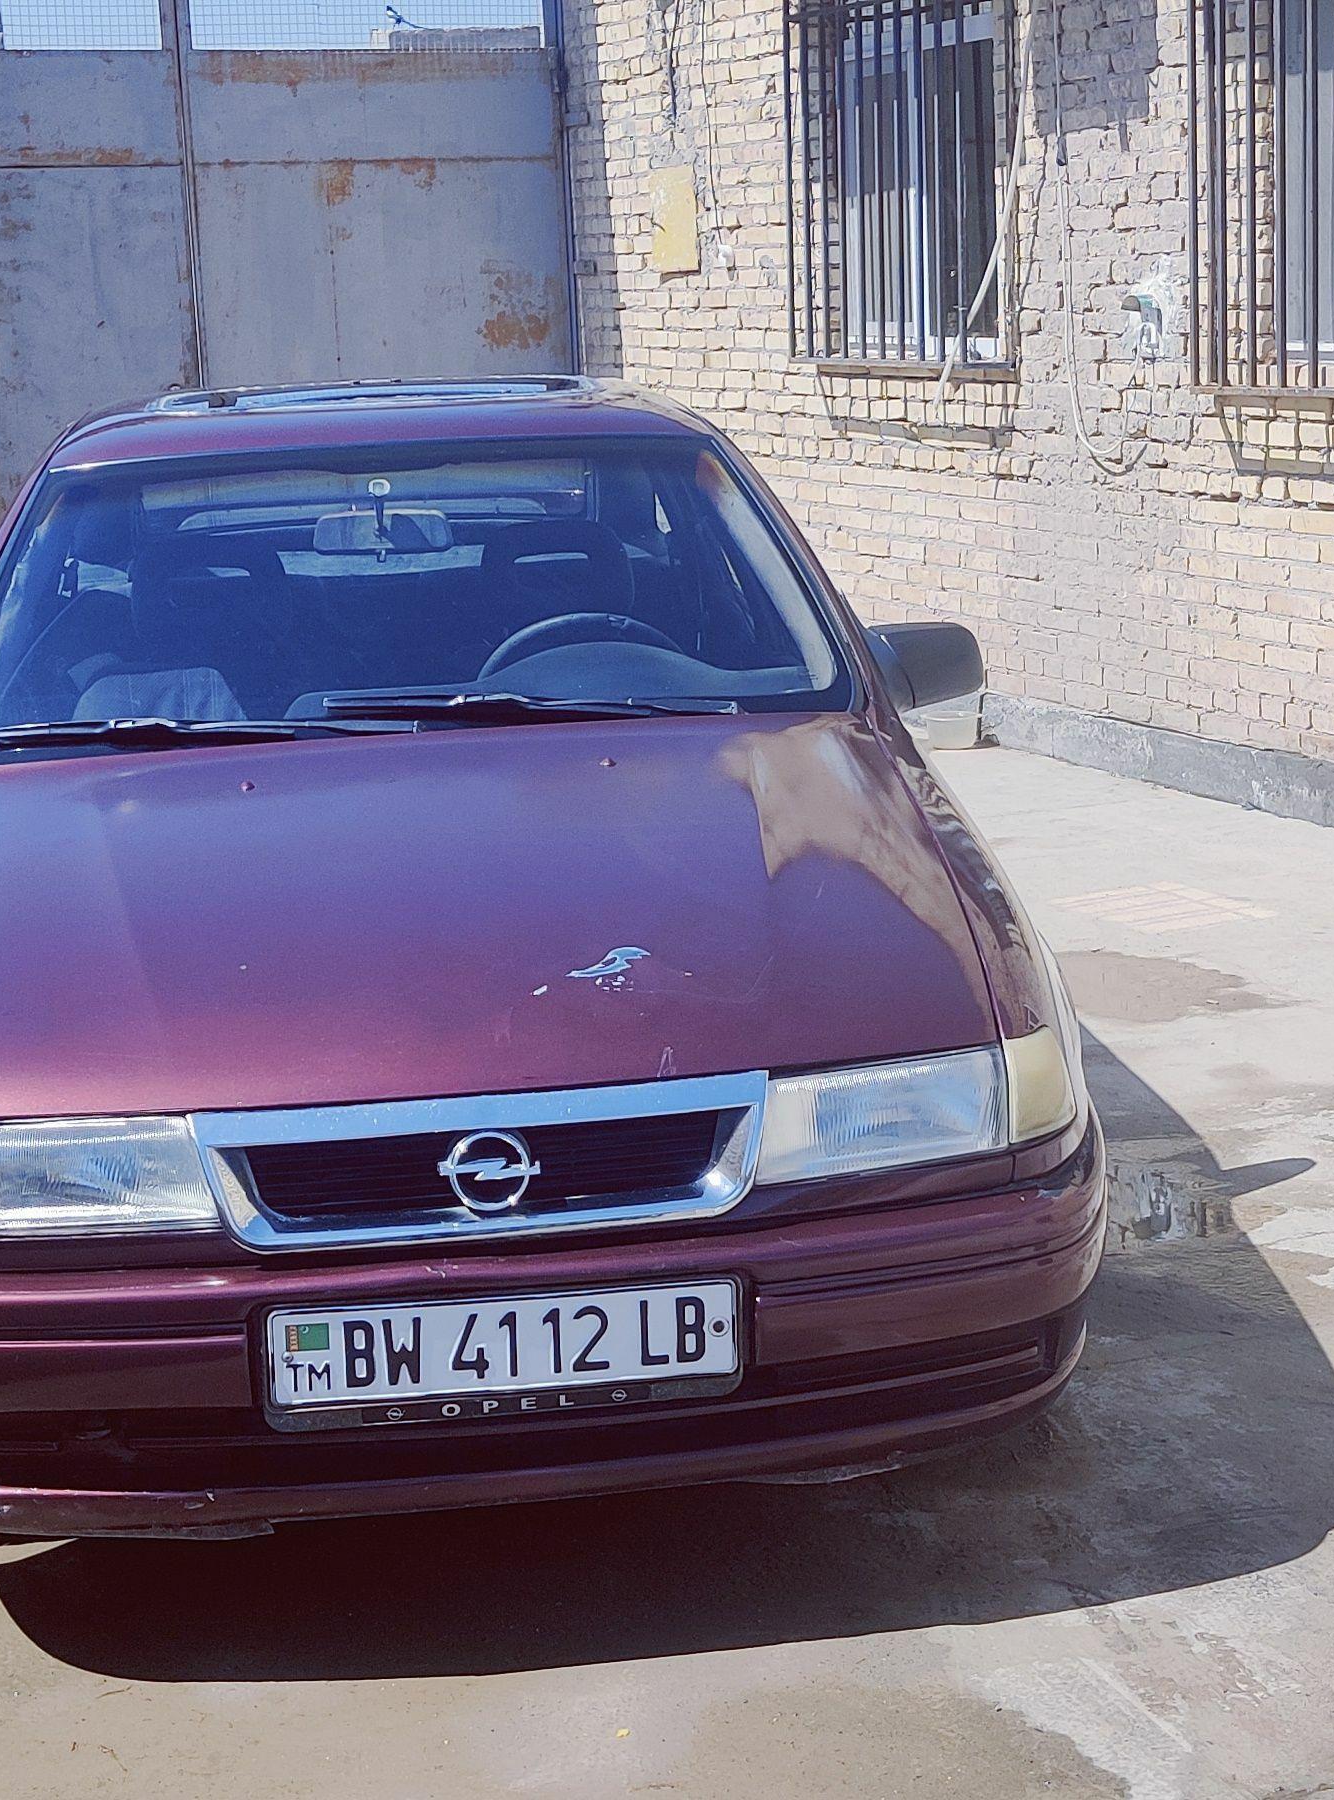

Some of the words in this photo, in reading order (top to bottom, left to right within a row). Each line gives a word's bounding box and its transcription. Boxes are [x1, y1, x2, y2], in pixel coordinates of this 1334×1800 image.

[342, 1317, 422, 1388] BW
[451, 1305, 610, 1380] 4112
[639, 1296, 706, 1366] LB
[285, 1361, 332, 1393] TM
[441, 1394, 575, 1417] OPEL
